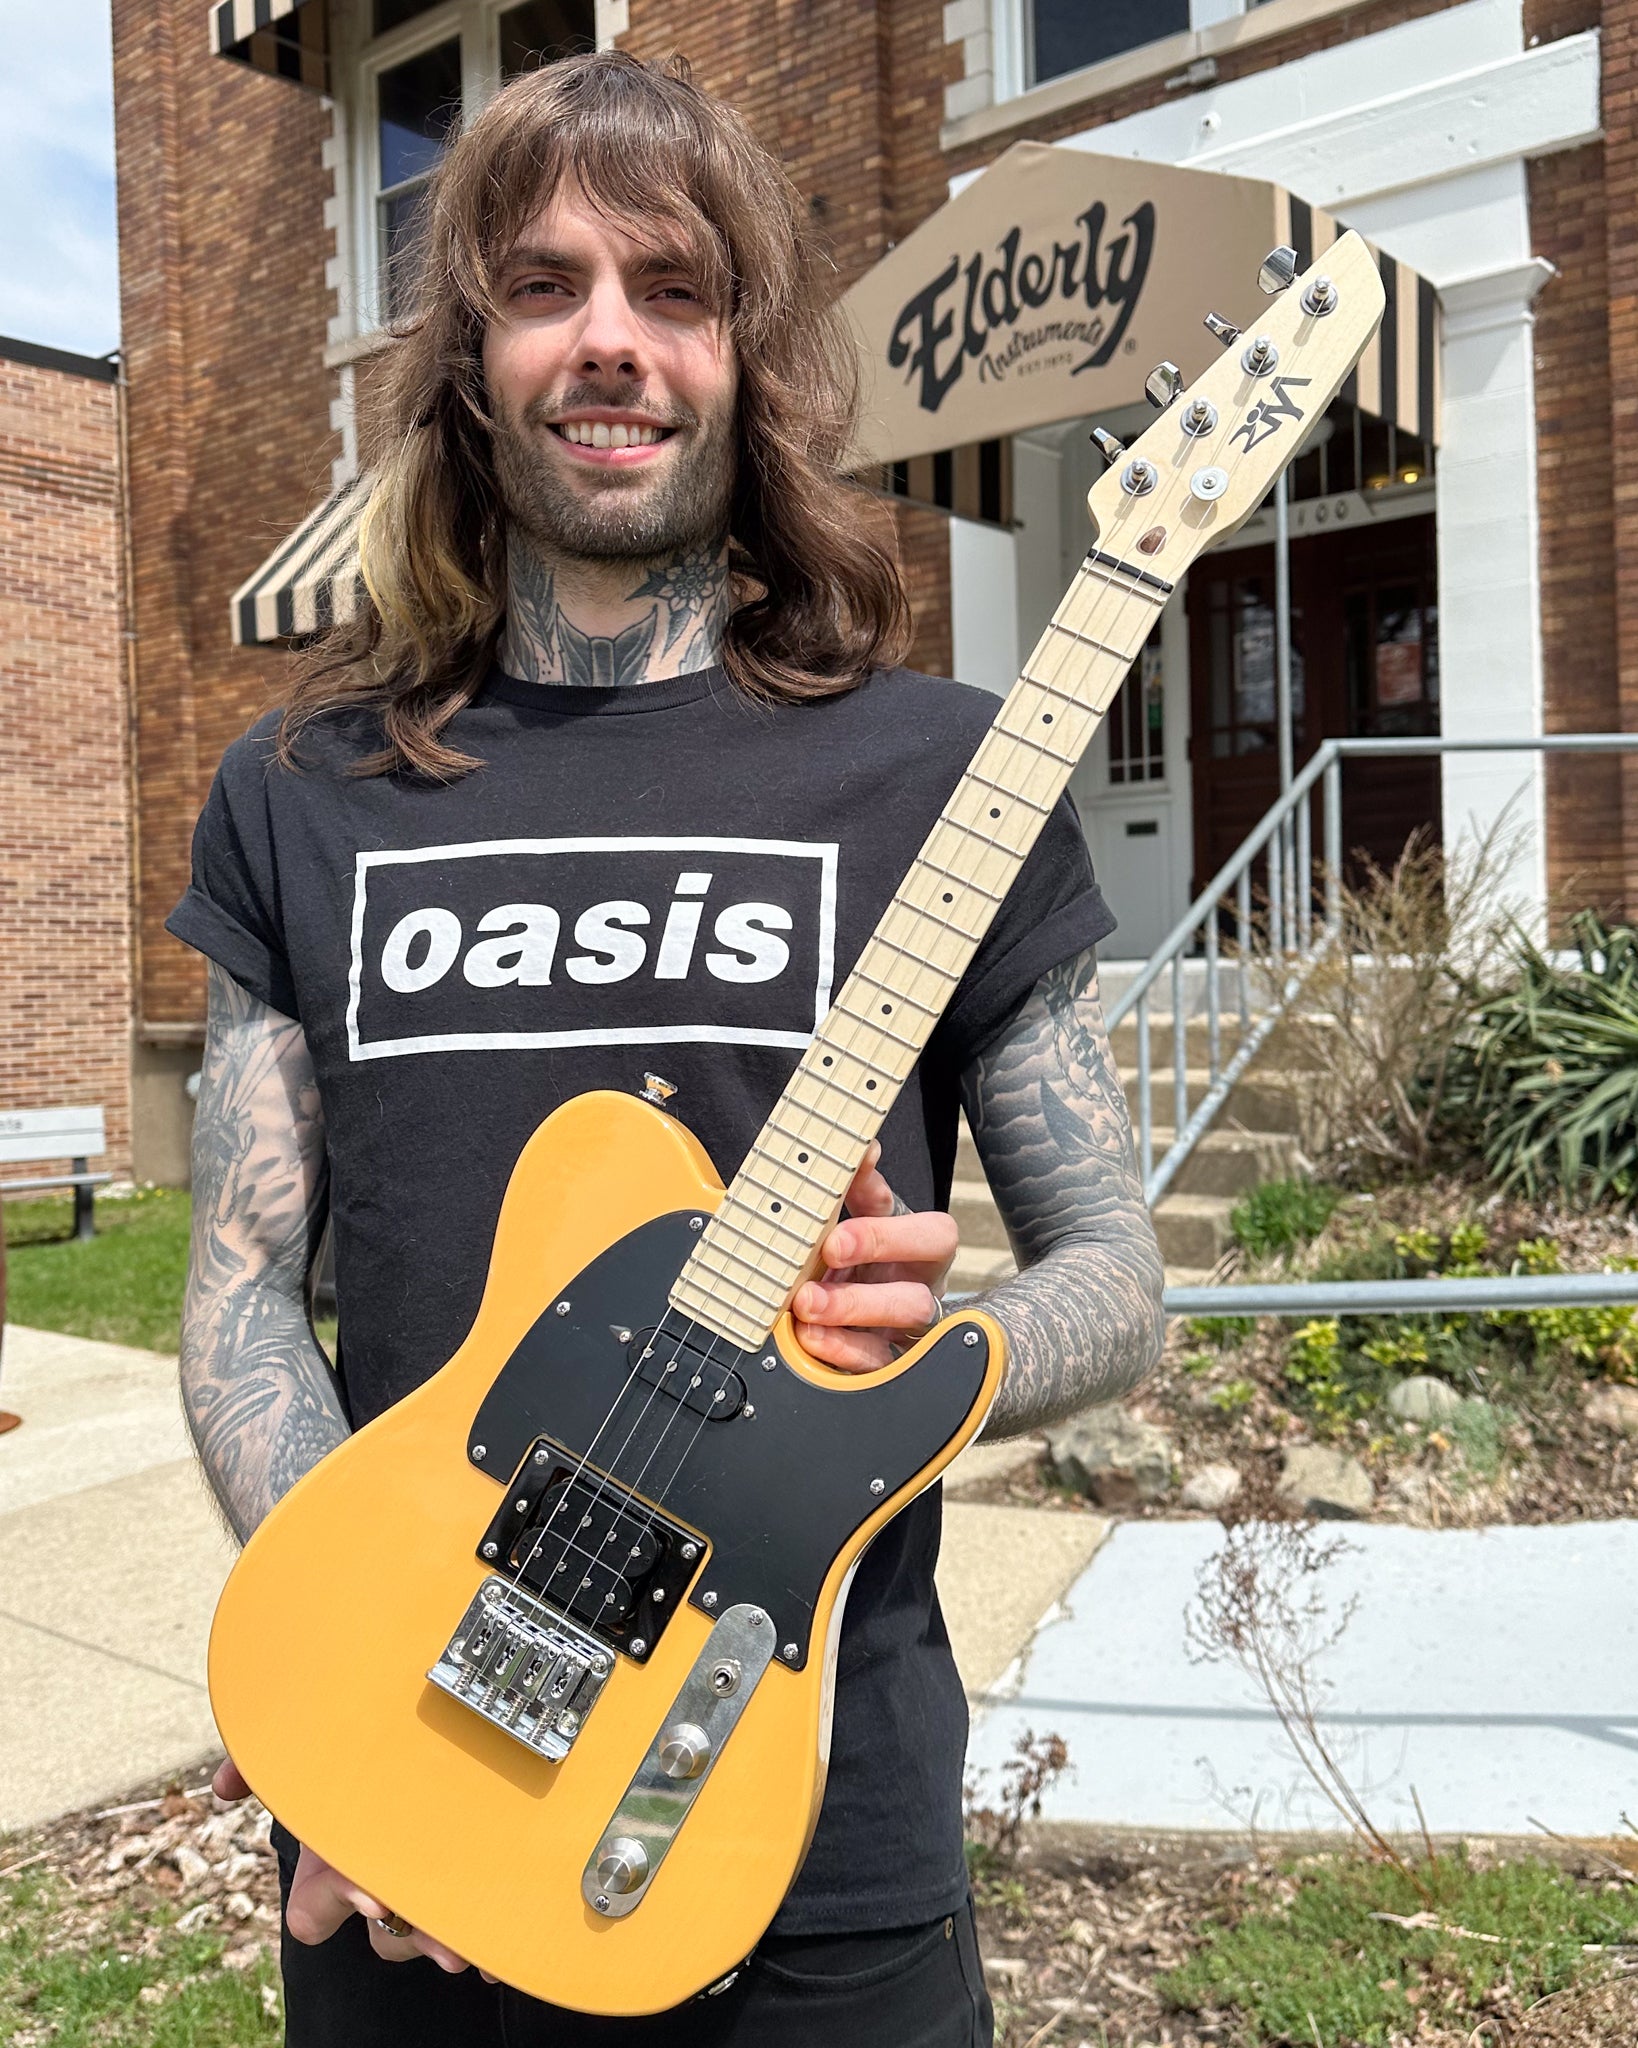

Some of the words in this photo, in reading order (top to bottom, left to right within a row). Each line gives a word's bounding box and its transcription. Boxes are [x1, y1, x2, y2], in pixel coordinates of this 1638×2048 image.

[888, 201, 1155, 413] Elderly
[1298, 499, 1348, 526] 100
[381, 873, 793, 993] oasis
